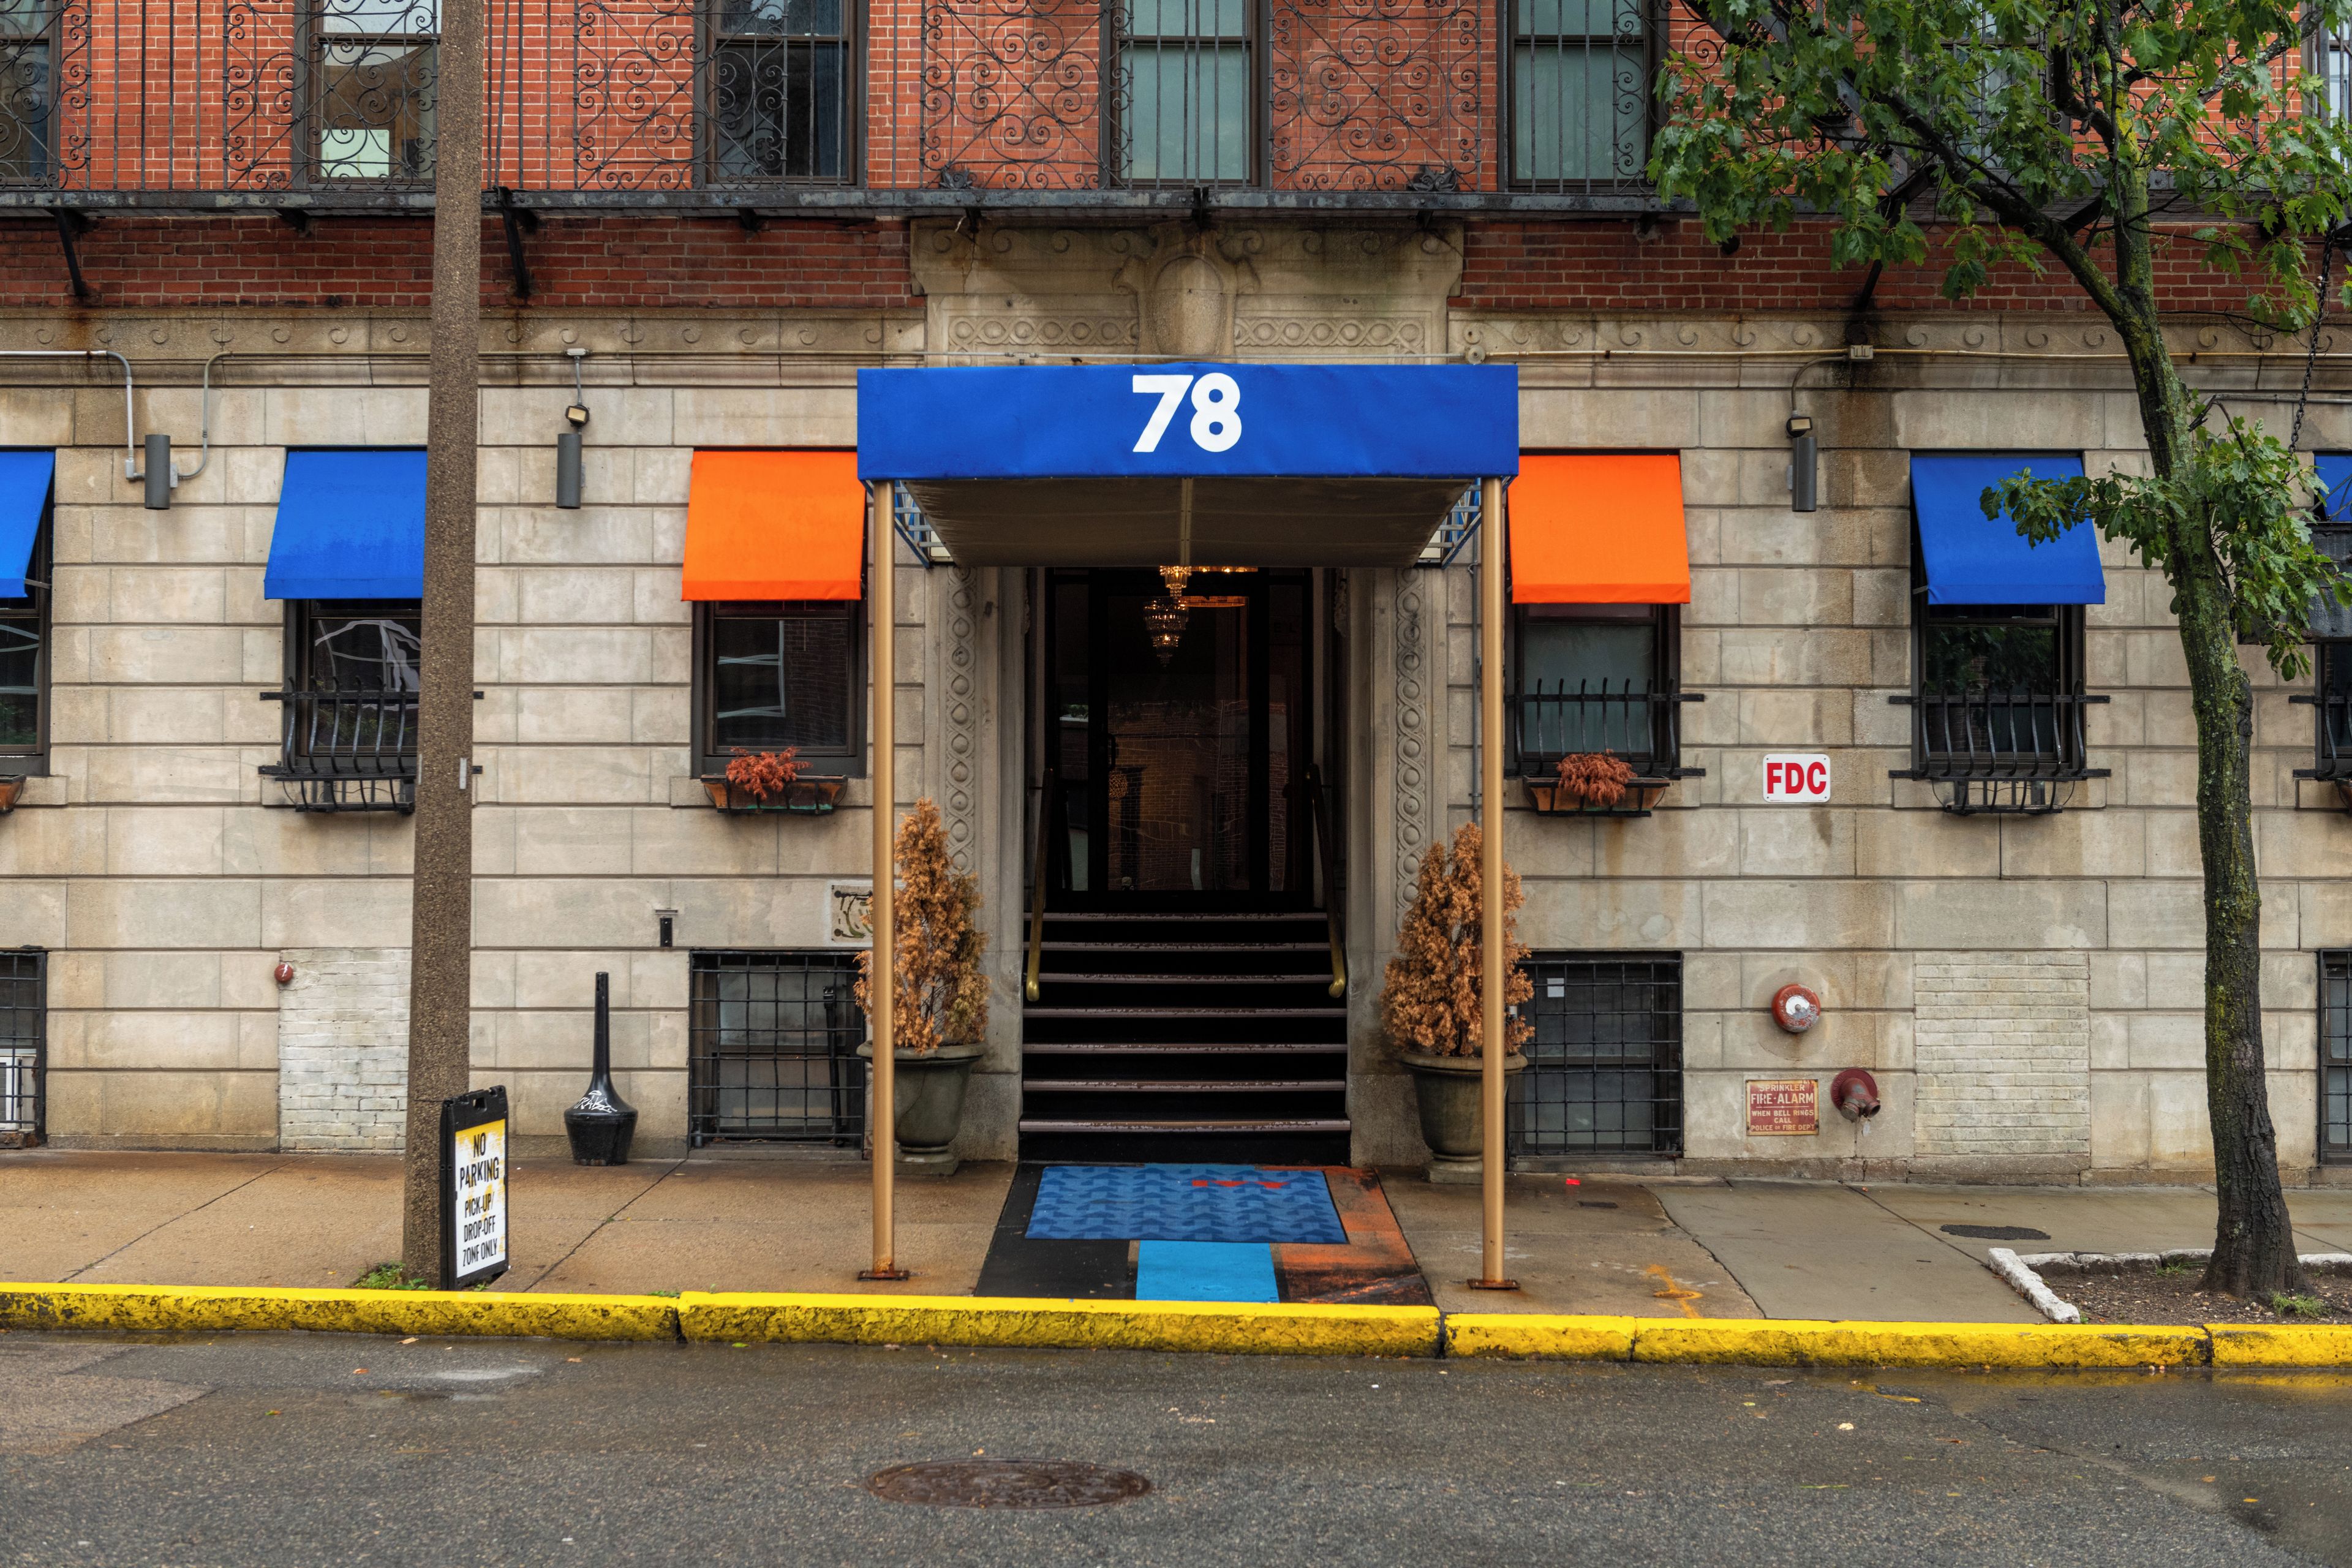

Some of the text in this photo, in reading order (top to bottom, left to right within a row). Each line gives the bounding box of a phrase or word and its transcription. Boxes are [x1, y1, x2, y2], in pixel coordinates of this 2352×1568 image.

[1133, 372, 1242, 452] 78
[1766, 761, 1826, 794] FDC
[473, 1133, 486, 1158] NO
[460, 1157, 499, 1191] PARKING
[464, 1215, 496, 1243] DROP-OFF
[463, 1238, 497, 1267] ZONE ONLY
